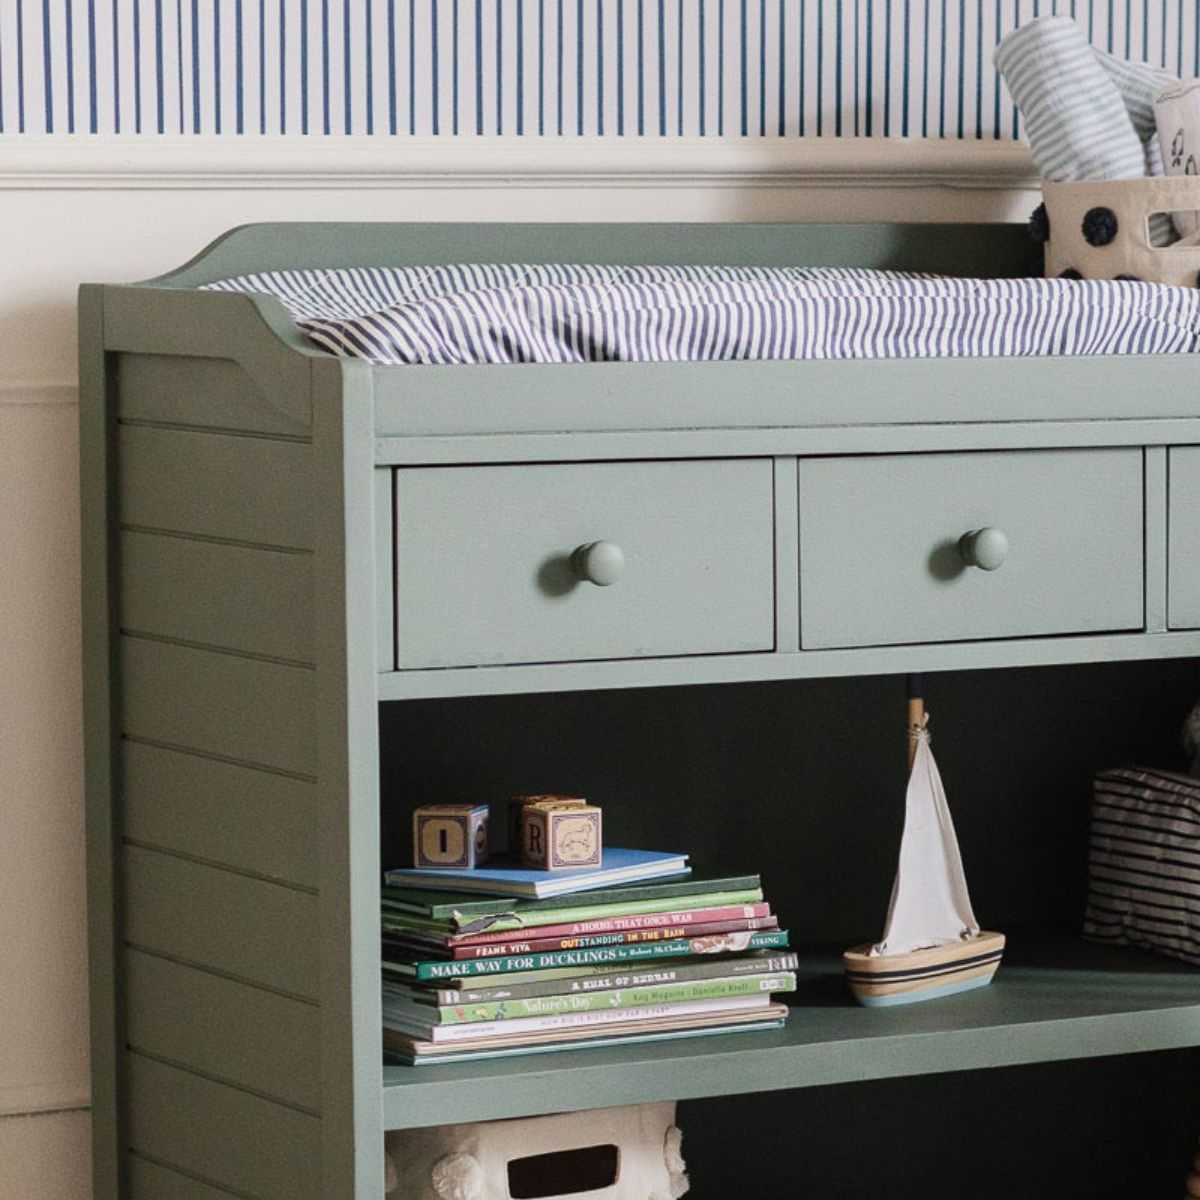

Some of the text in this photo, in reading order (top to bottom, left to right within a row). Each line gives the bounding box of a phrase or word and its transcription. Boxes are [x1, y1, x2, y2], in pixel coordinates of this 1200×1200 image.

[440, 829, 447, 853] I
[529, 824, 542, 854] R
[614, 919, 643, 929] THAT
[671, 913, 692, 923] WAS
[560, 929, 685, 948] OUTSTANDING IN THE RAIN
[751, 936, 779, 945] VIKING
[476, 943, 530, 957] FRANK VIVA
[431, 963, 470, 977] MAKE
[475, 960, 502, 973] WAY
[507, 958, 534, 969] FOR
[540, 949, 616, 966] DUCKLINGS
[572, 997, 593, 1009] Day
